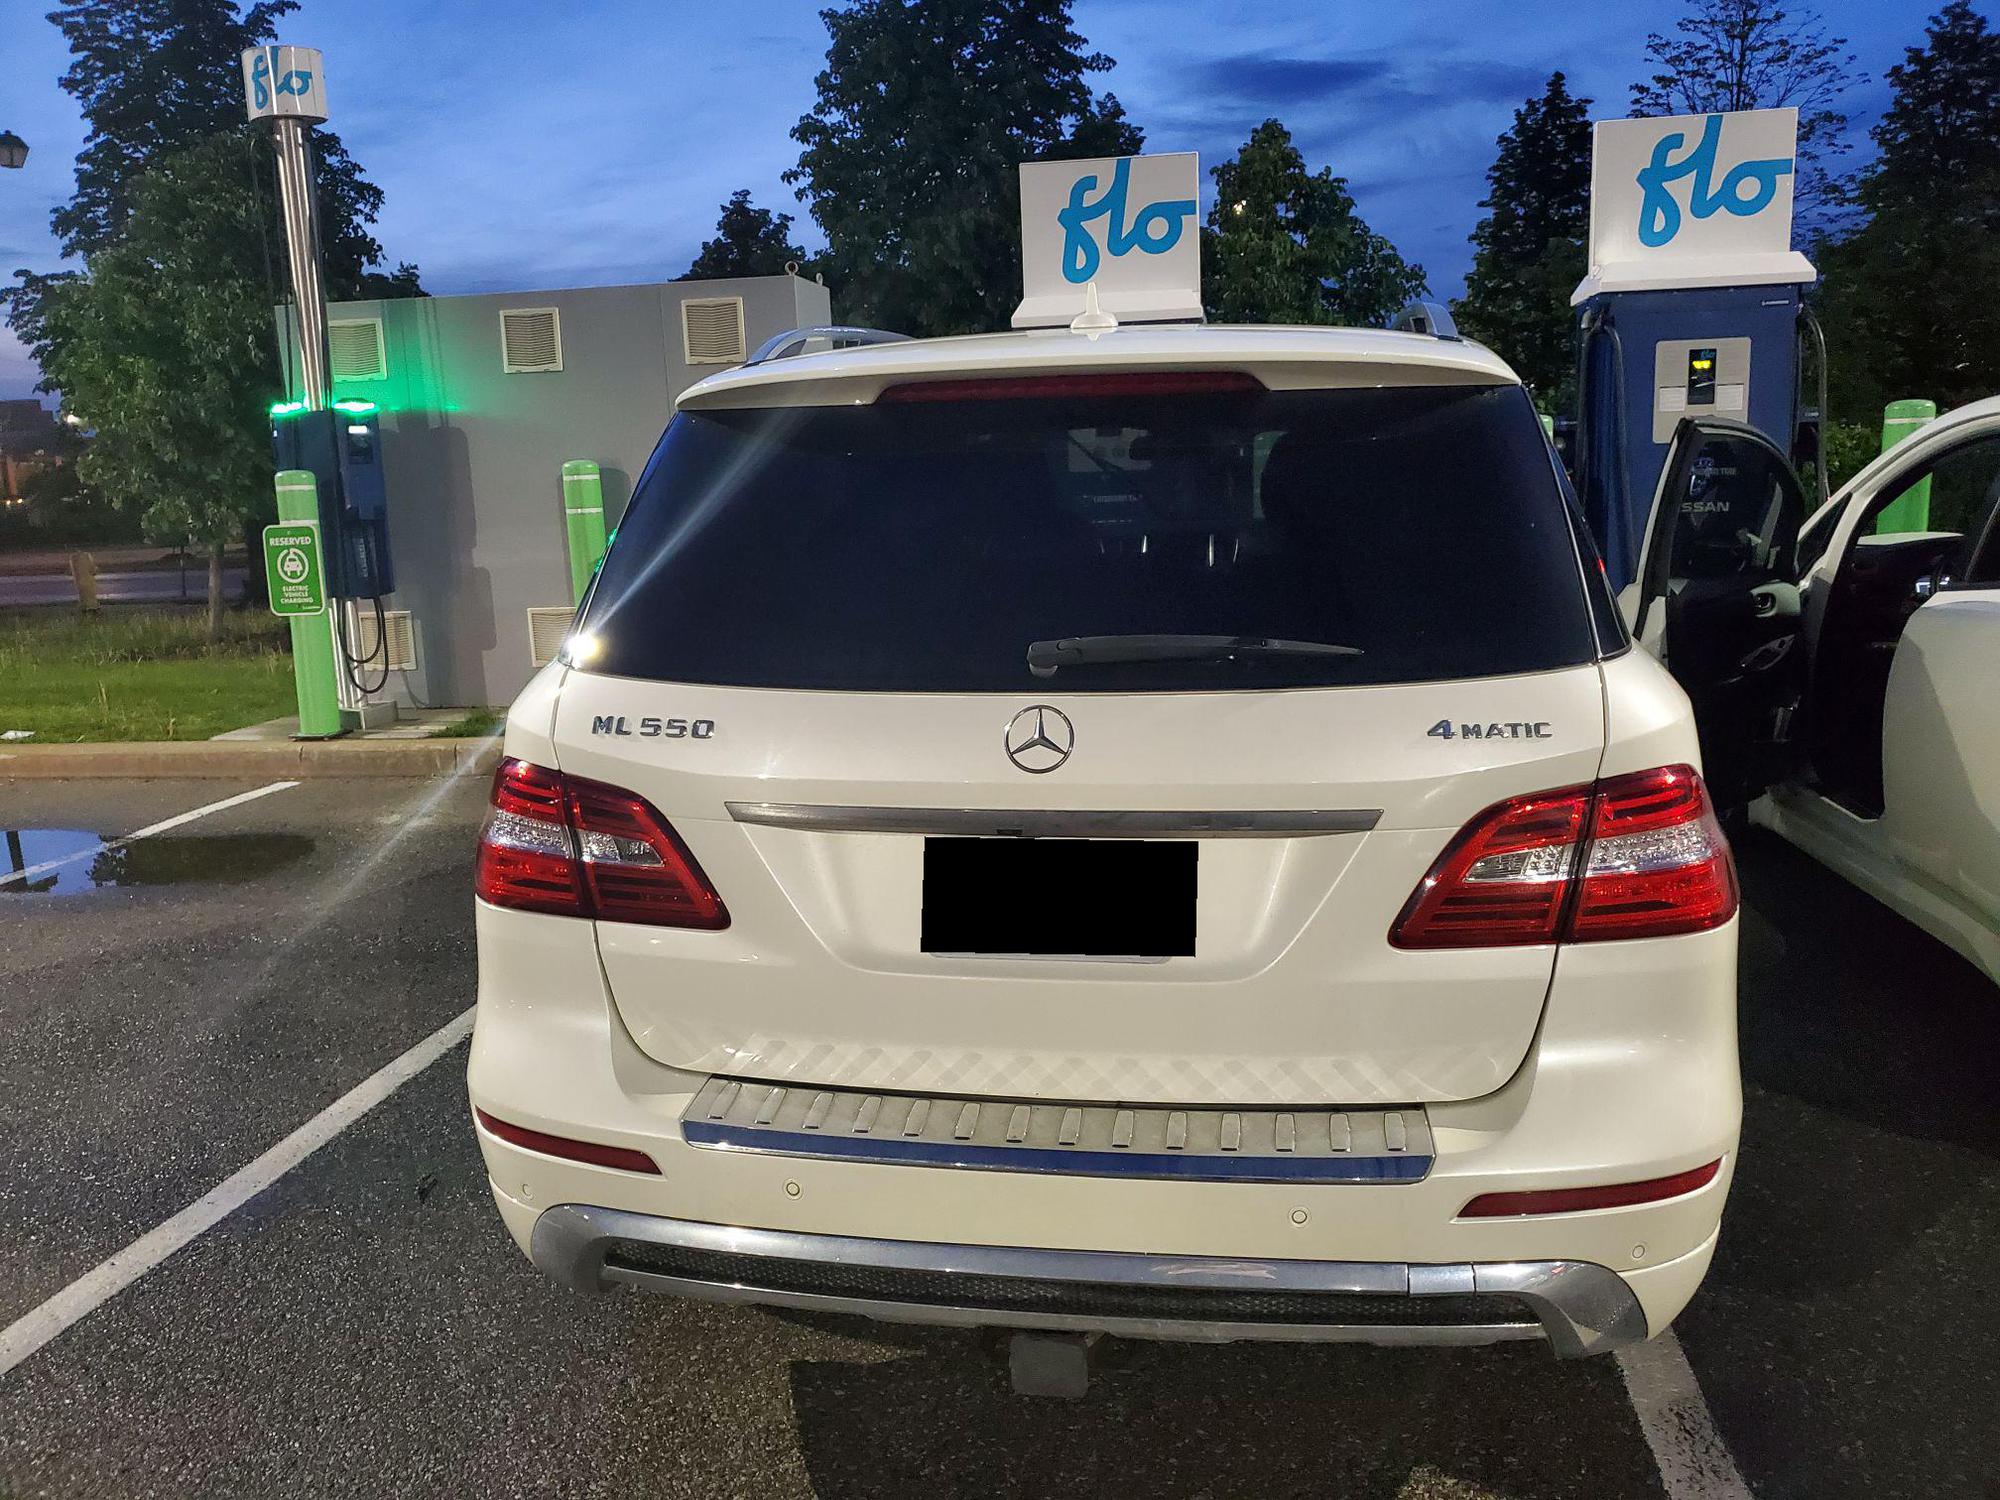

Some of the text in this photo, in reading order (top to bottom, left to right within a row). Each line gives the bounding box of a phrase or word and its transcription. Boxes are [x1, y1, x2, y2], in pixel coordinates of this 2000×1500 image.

[252, 46, 312, 110] flo
[1636, 114, 1794, 247] flo
[1057, 157, 1197, 283] flo
[1681, 501, 1730, 512] SSAN
[269, 536, 312, 546] RESERVED
[592, 716, 714, 739] ML 550
